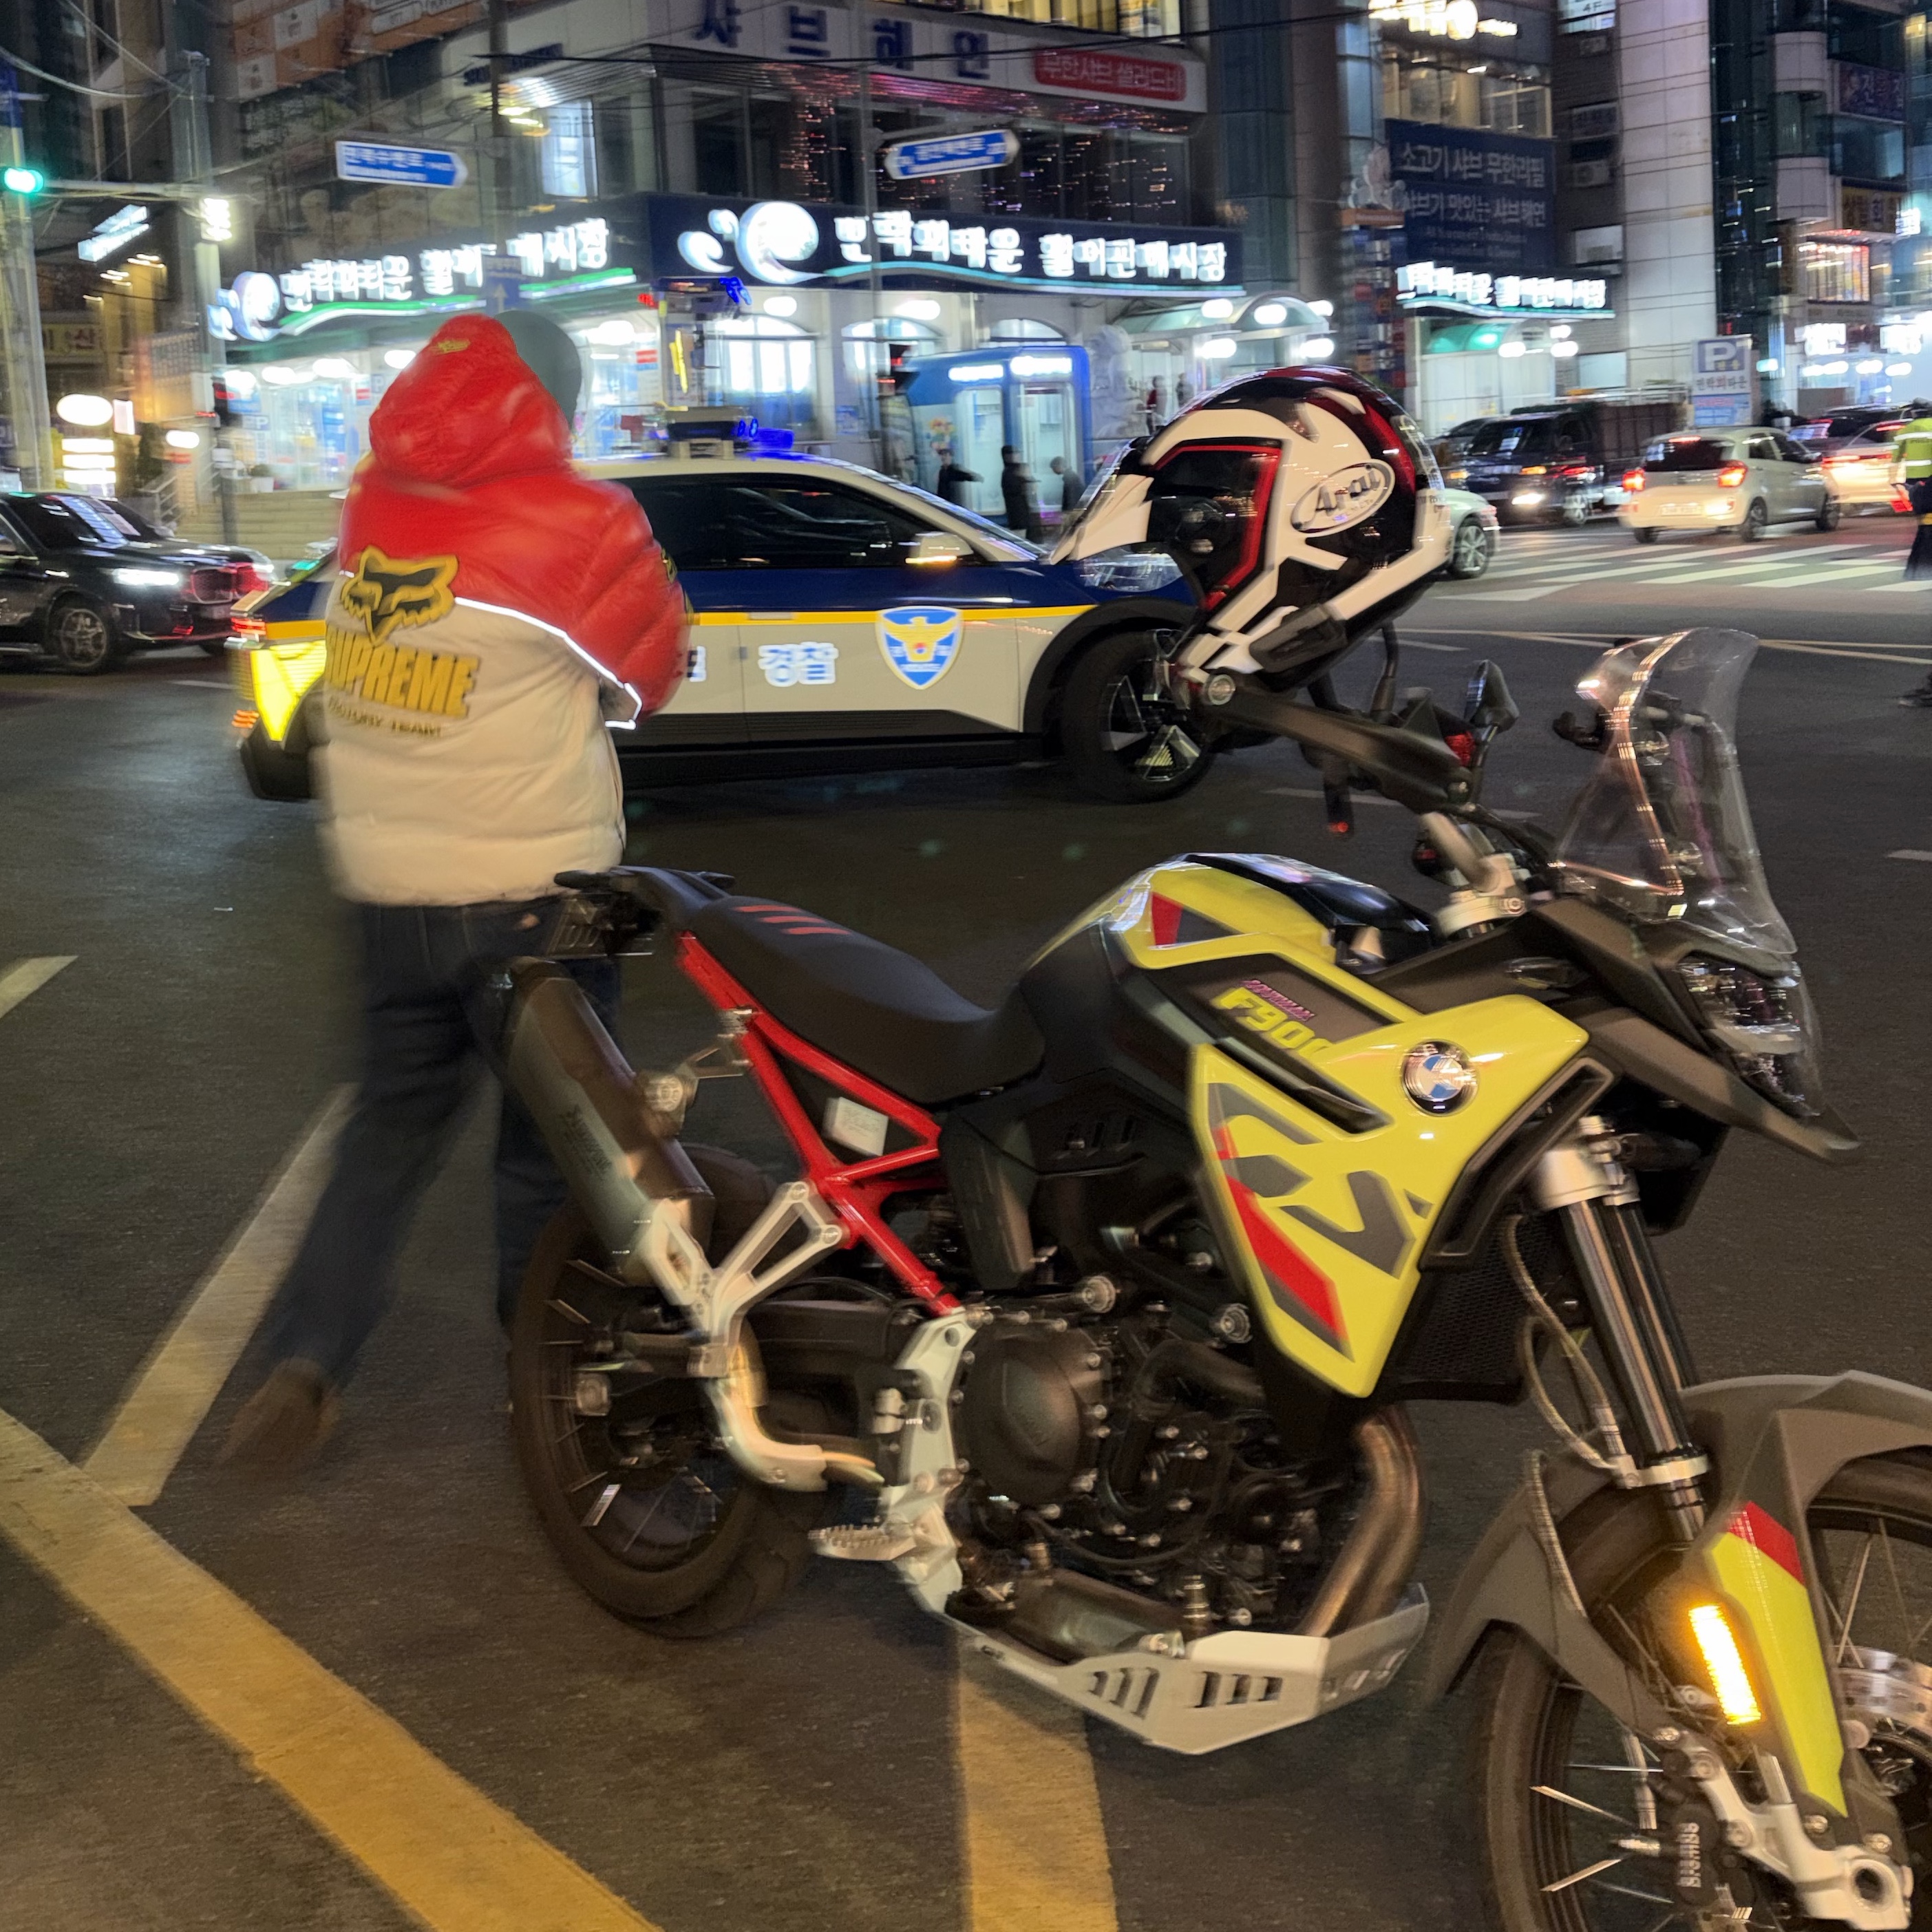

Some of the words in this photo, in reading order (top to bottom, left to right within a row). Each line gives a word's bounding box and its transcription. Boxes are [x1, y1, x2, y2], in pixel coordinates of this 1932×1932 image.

[1401, 142, 1448, 178] 소고기
[1452, 147, 1483, 180] 샤브
[1486, 151, 1546, 188] 무한리필
[834, 210, 1024, 273] 민락회타운
[1039, 233, 1226, 282] 활어판매시장
[1705, 342, 1736, 370] P
[758, 641, 839, 687] 경찰
[1677, 1822, 1701, 1887] brembo
